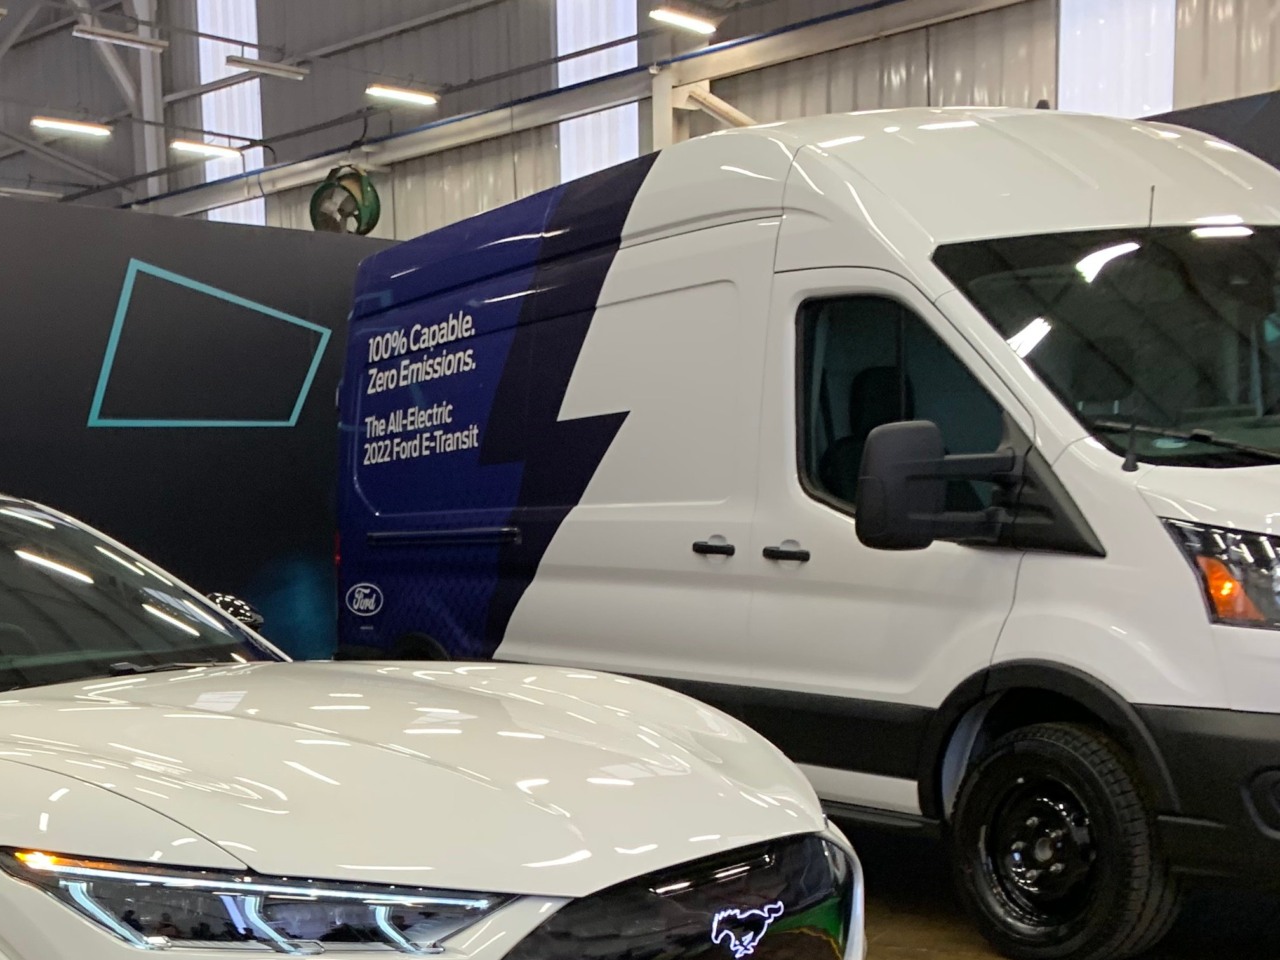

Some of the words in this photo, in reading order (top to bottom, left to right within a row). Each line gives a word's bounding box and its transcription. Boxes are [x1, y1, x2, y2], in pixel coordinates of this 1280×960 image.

[368, 329, 408, 363] 100%
[409, 310, 476, 352] Capable.
[367, 368, 397, 395] Zero
[399, 349, 476, 387] Emissions.
[364, 415, 386, 439] The
[387, 400, 453, 435] All-Electric
[363, 439, 391, 466] 2022
[392, 434, 420, 461] Ford
[421, 424, 479, 456] E-Transit
[352, 587, 377, 611] Ford
